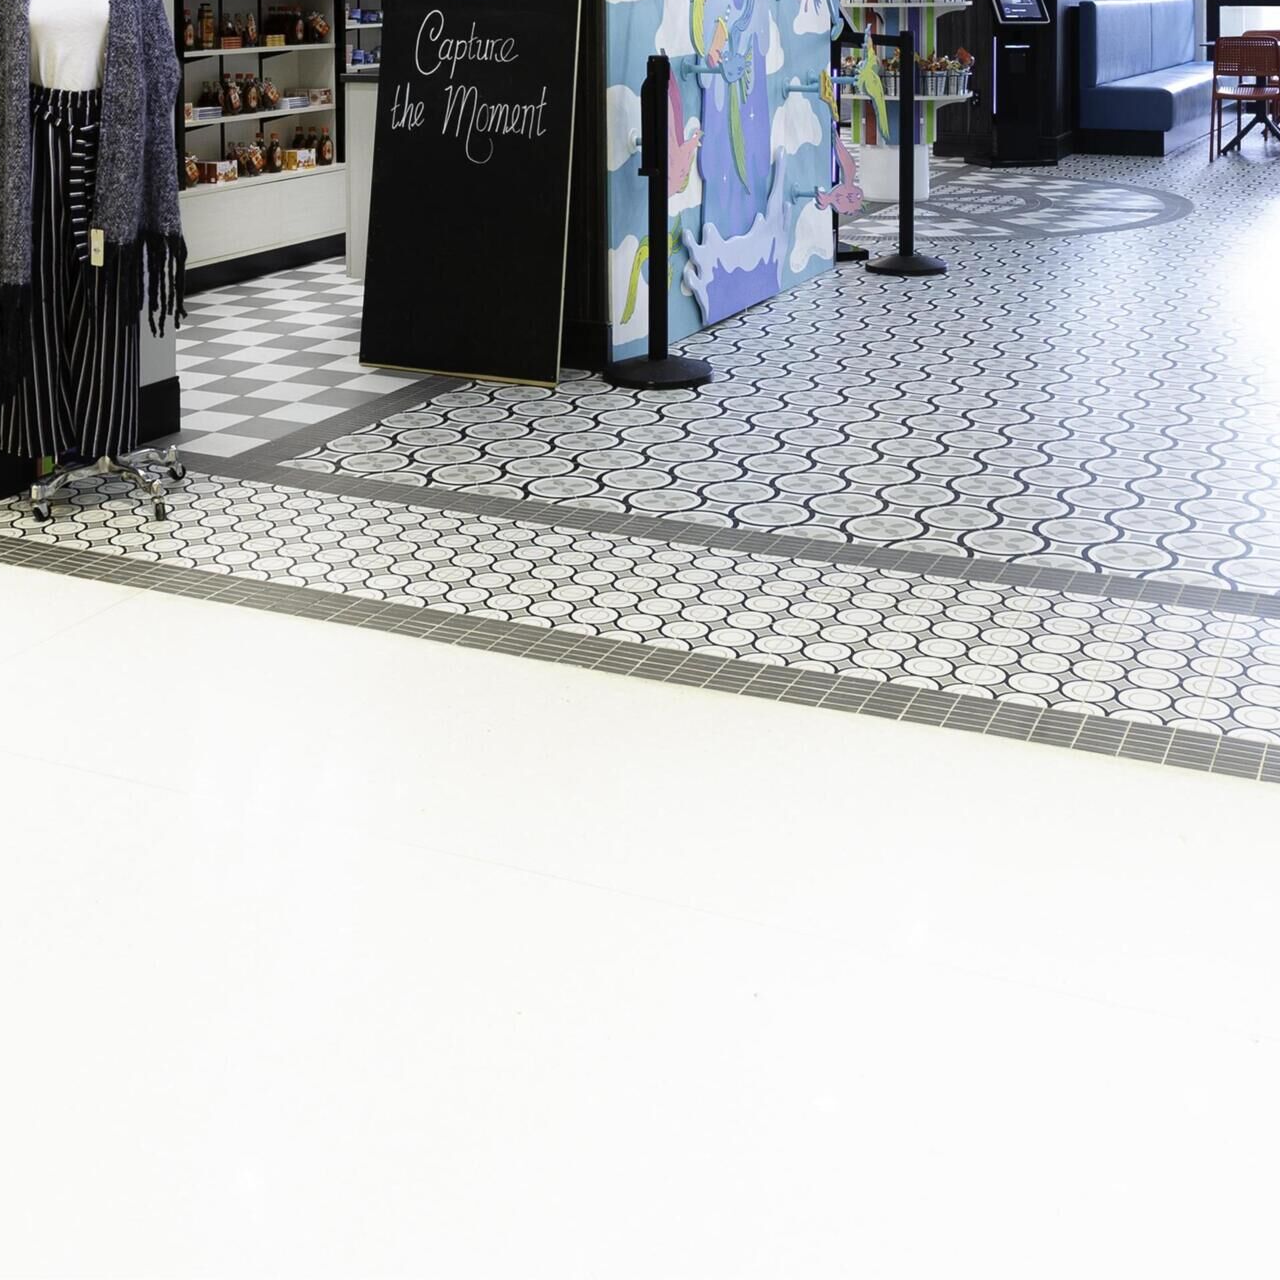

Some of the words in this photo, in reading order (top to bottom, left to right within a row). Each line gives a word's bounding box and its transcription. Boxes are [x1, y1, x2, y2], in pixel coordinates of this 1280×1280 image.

[415, 10, 519, 78] Capture
[390, 82, 424, 131] the
[442, 85, 548, 163] Moment
